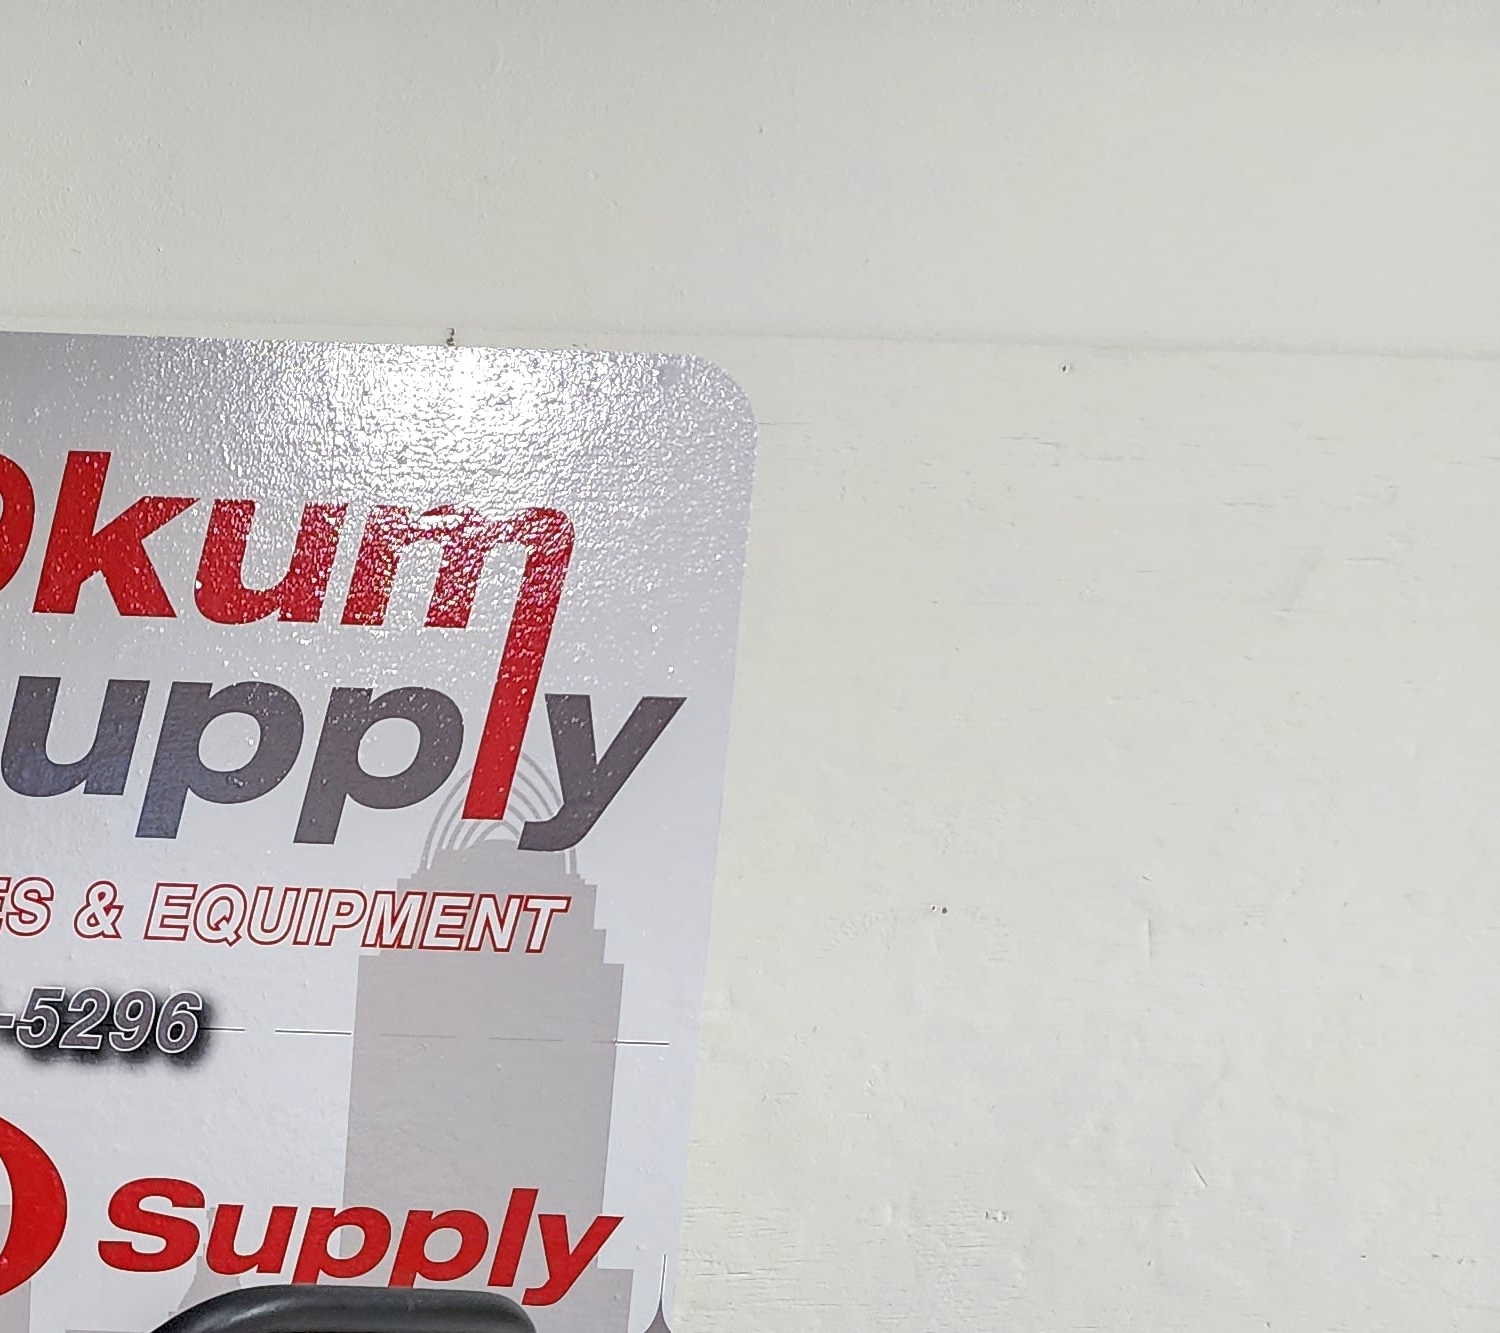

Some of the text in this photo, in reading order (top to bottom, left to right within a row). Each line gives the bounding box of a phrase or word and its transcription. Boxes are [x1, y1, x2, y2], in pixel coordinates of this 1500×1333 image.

[74, 881, 123, 941] &
[143, 882, 570, 954] EQUIPMENT
[98, 1177, 625, 1305] Supply
